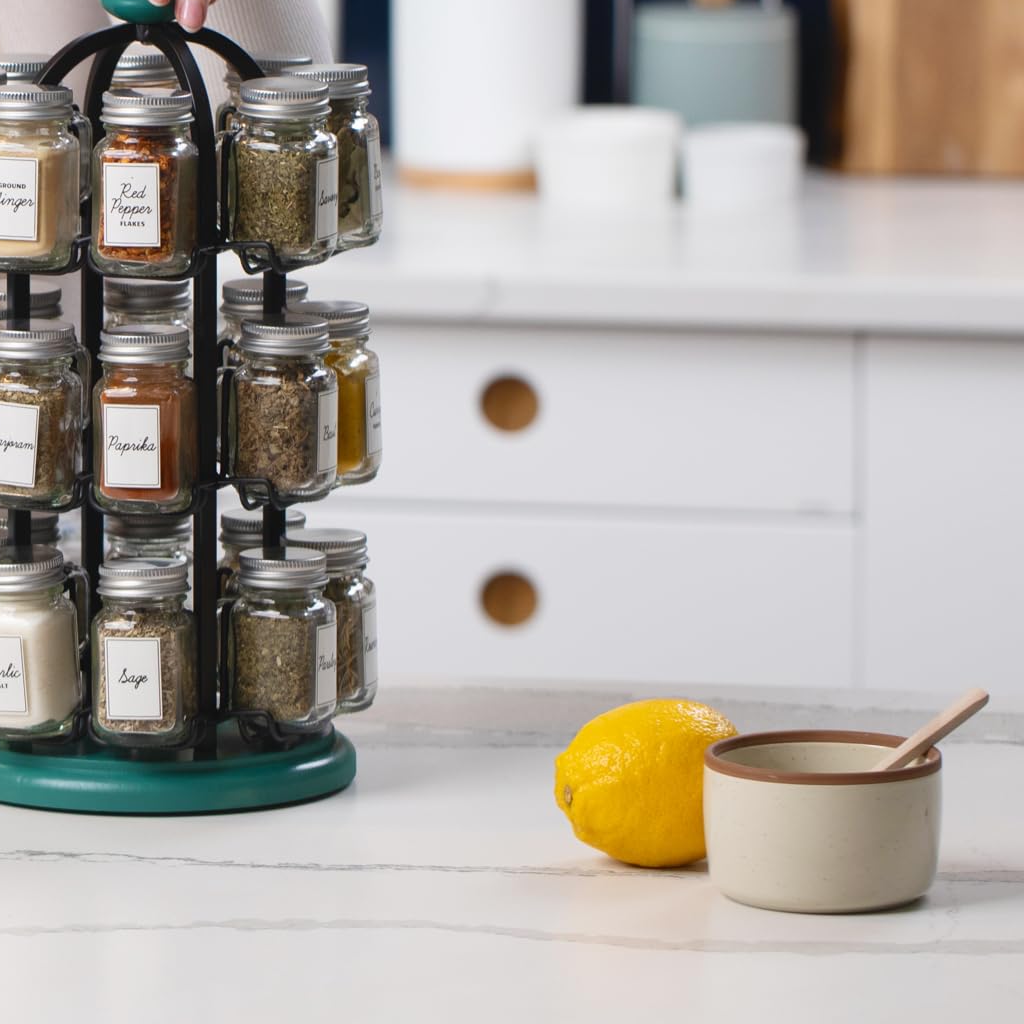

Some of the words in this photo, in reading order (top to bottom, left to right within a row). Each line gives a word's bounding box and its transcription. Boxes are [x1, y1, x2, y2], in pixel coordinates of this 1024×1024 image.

[120, 182, 147, 199] Red
[111, 197, 153, 219] Pepper
[108, 435, 157, 456] Paprika
[118, 667, 148, 689] Sage
